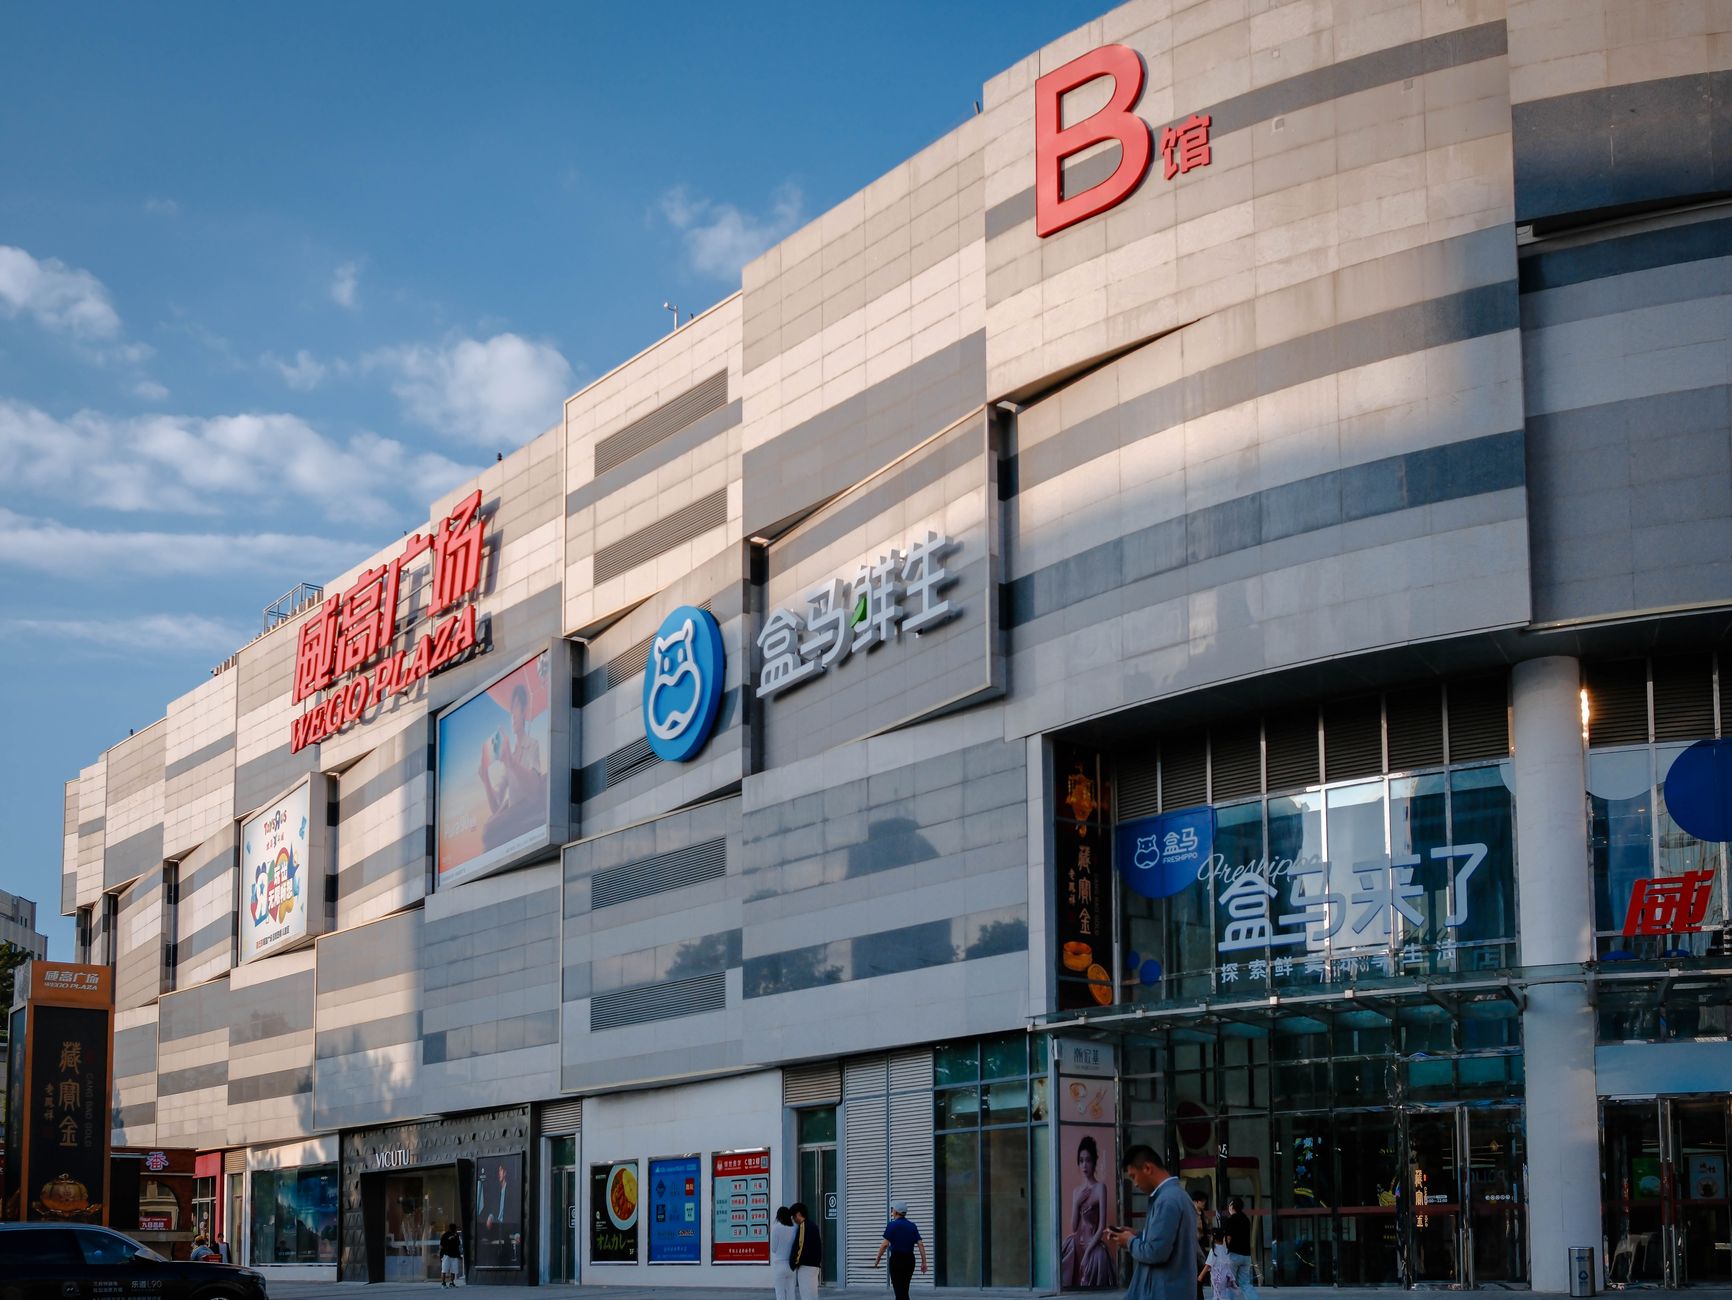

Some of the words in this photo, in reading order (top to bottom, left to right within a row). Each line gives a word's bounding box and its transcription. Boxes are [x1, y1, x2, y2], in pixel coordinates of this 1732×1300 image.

[1035, 43, 1151, 239] B
[1160, 114, 1211, 180] 馆
[292, 489, 485, 706] 威高广场
[756, 531, 954, 698] 盒马鲜生
[291, 675, 369, 755] WEGO
[370, 604, 476, 707] PLAZA
[1163, 827, 1198, 856] 盒马
[1163, 852, 1198, 864] FRESHIPPO
[1218, 842, 1488, 952] 盒马来了
[376, 1148, 410, 1169] VICUTU
